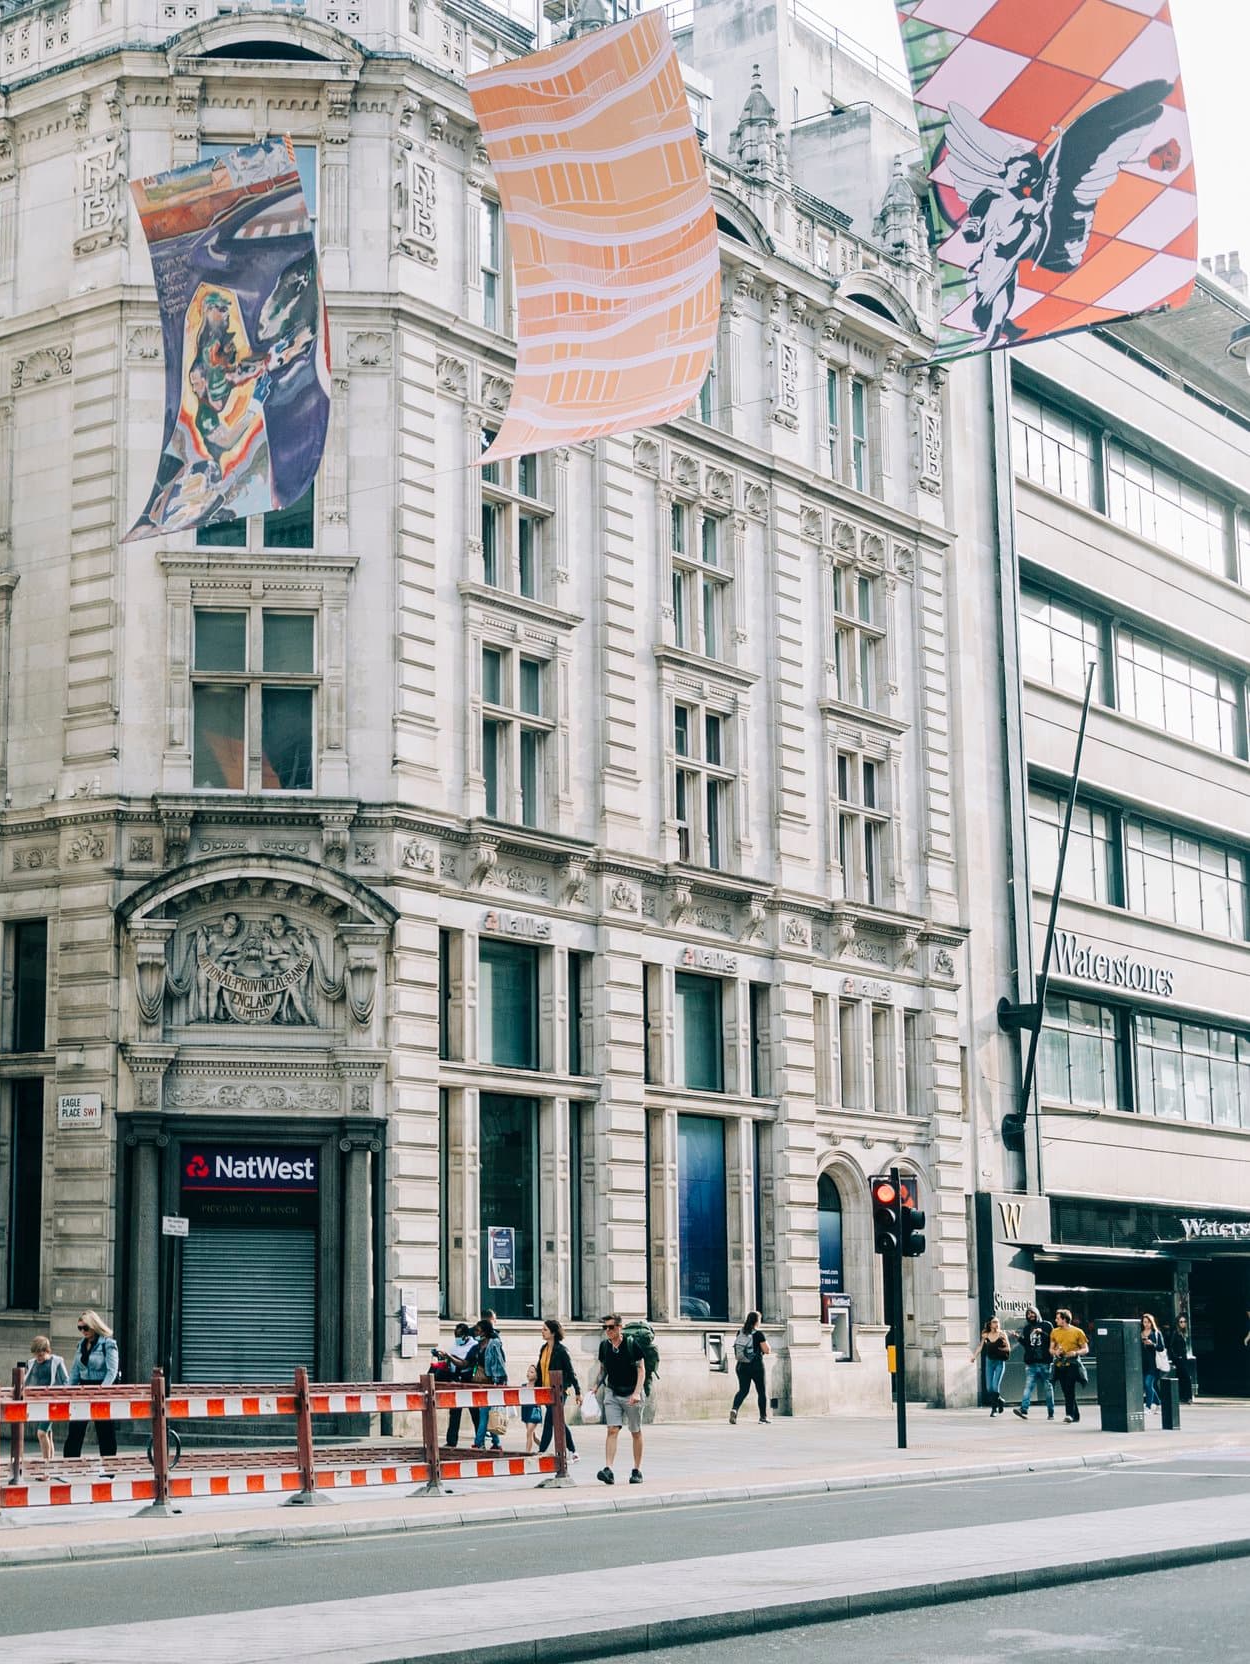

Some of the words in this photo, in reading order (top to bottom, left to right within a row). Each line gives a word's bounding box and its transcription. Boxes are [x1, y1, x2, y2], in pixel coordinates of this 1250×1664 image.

[1053, 932, 1174, 997] Waterstones
[233, 993, 274, 1009] ENGLAND
[238, 1007, 270, 1019] LIMITED
[62, 1098, 81, 1107] EAGLE
[62, 1108, 81, 1117] PLACE
[83, 1107, 97, 1117] SW1
[215, 1155, 315, 1180] NatWest
[997, 1202, 1024, 1240] W
[1180, 1218, 1250, 1237] Waters
